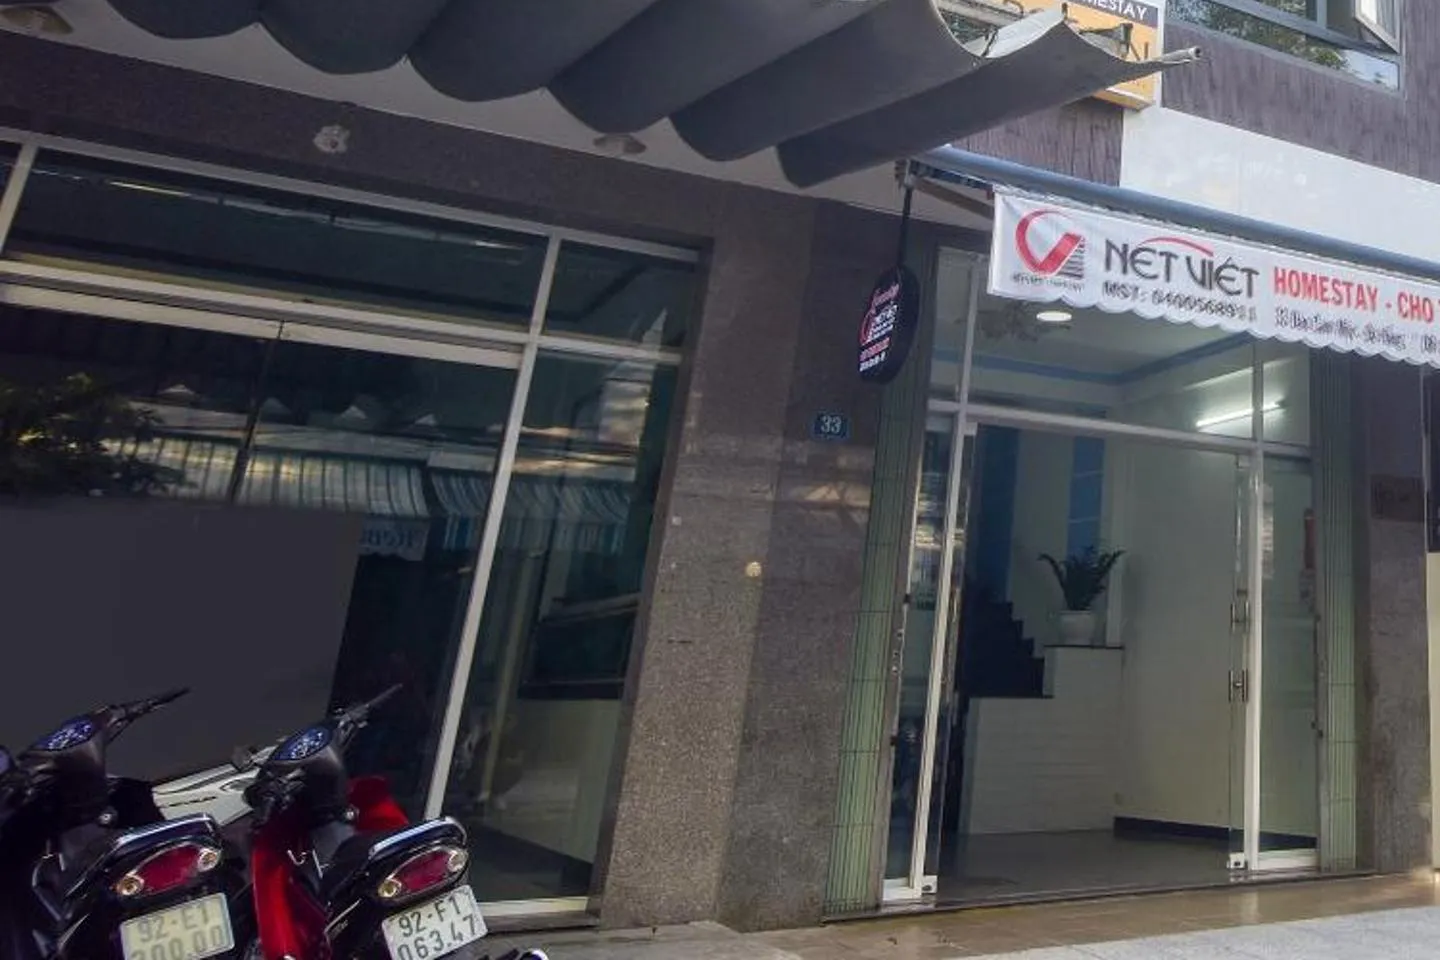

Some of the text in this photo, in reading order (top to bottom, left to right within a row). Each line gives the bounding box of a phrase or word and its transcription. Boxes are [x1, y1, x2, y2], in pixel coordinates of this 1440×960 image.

[1104, 238, 1179, 282] NET
[1273, 266, 1379, 312] HOMESTAY
[1397, 292, 1434, 324] CHO
[821, 414, 842, 434] 33
